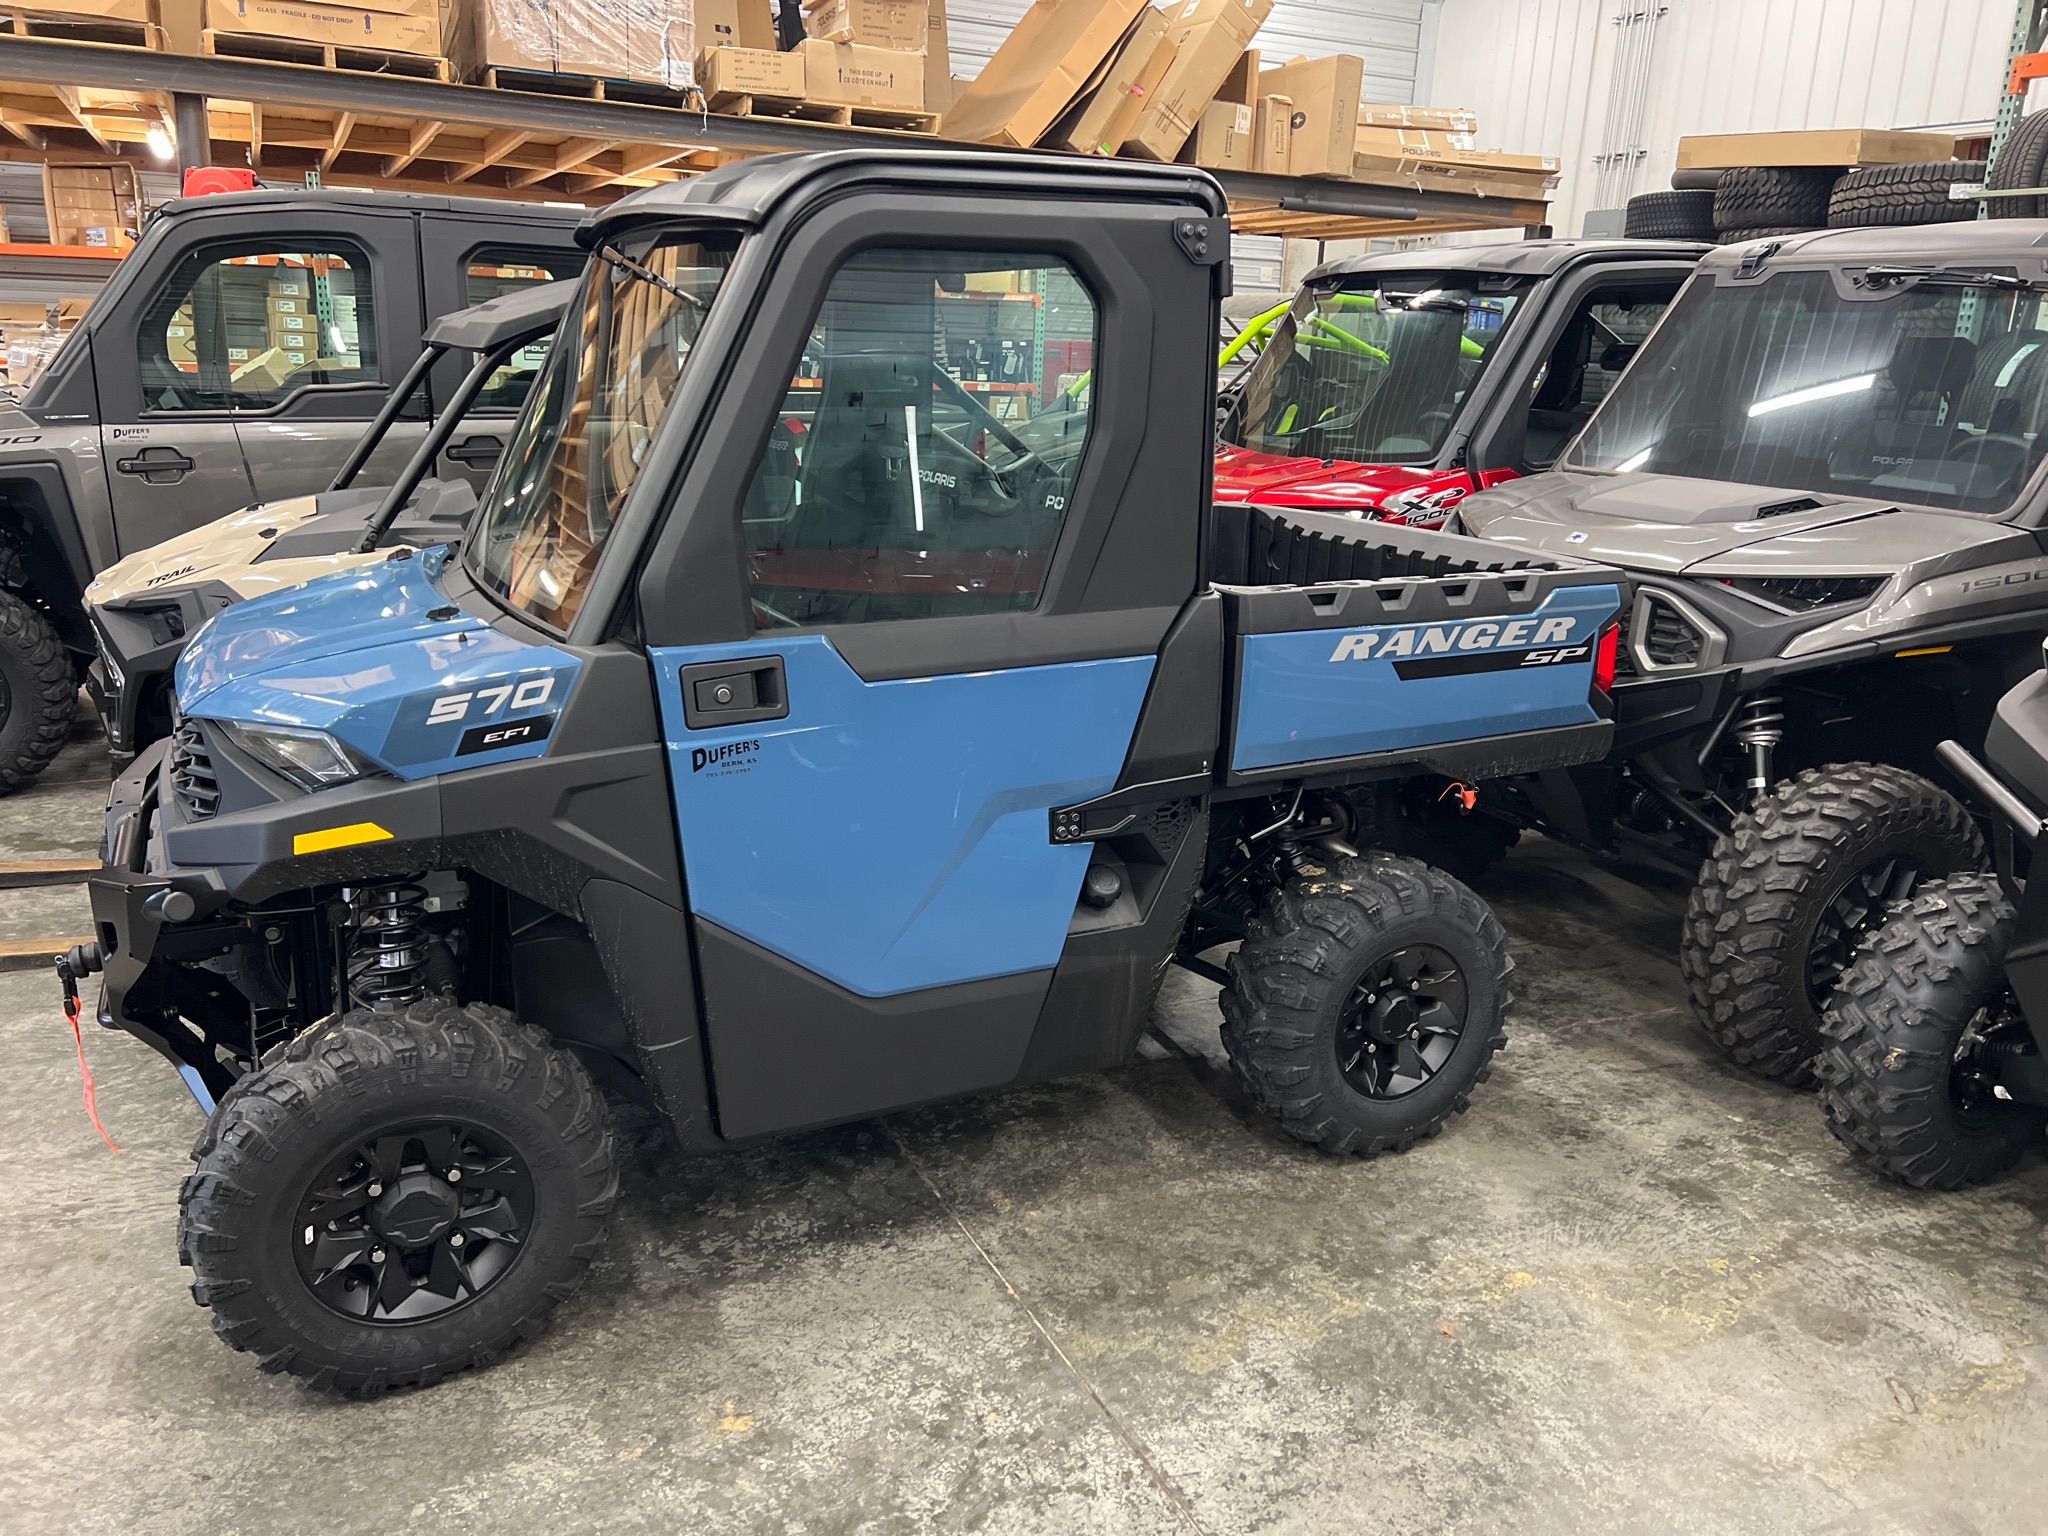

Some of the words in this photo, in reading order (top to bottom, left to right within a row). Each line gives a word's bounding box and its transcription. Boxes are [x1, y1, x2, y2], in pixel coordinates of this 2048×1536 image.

[256, 7, 278, 15] GLASS
[281, 9, 308, 19] FRAGILE
[311, 13, 322, 21] DO
[849, 68, 861, 76] THIS
[862, 69, 874, 77] SIDE
[874, 79, 889, 87] HAUT
[1417, 164, 1456, 175] POLARI
[918, 469, 957, 488] POLARIS
[1396, 487, 1467, 518] XP
[146, 565, 195, 587] TRAIL
[1329, 617, 1577, 662] RANGER
[1520, 646, 1589, 666] SP
[425, 677, 555, 725] 570
[483, 726, 531, 743] EFI
[691, 740, 760, 773] DUFFER'S
